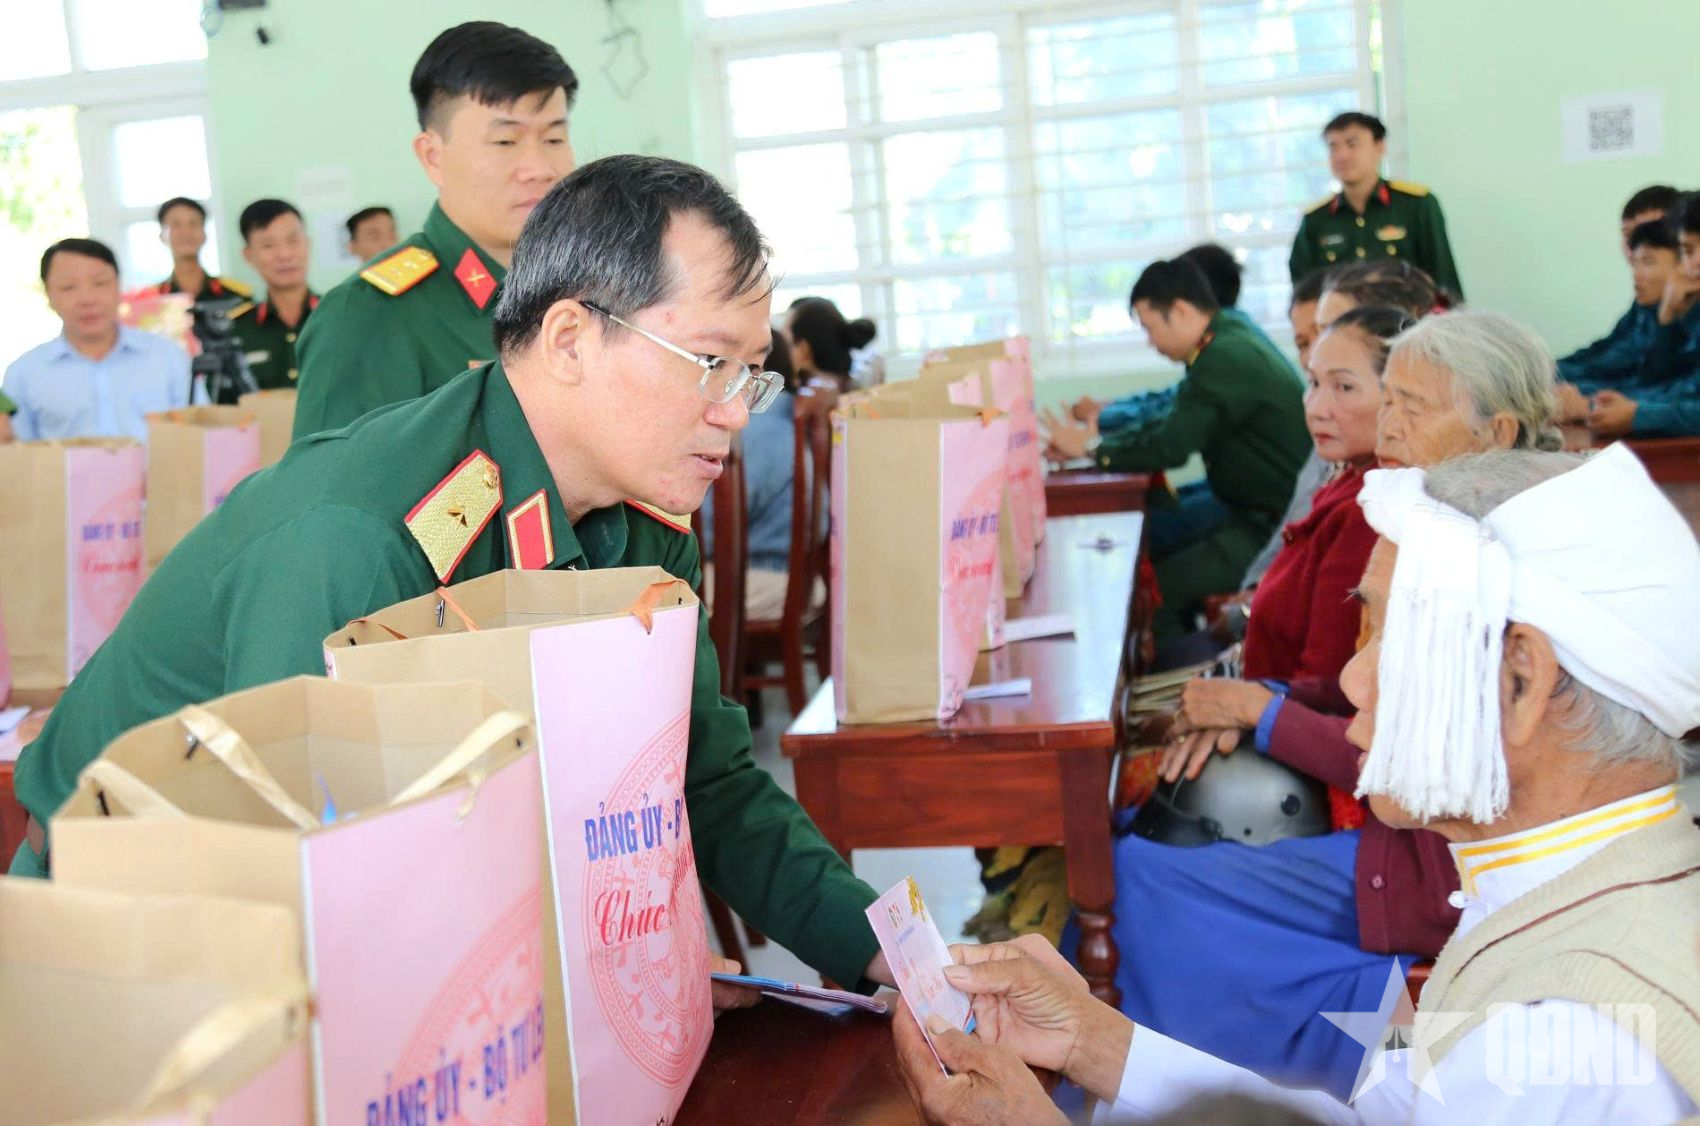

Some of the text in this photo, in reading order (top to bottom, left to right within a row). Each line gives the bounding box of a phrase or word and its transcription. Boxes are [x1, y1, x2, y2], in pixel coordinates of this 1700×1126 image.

[584, 801, 638, 862] ĐẢNG
[641, 793, 663, 857] ỦY
[675, 798, 684, 839] B
[595, 889, 665, 946] Chúc
[435, 1047, 462, 1122] ỦY
[484, 1025, 508, 1105] BỘ
